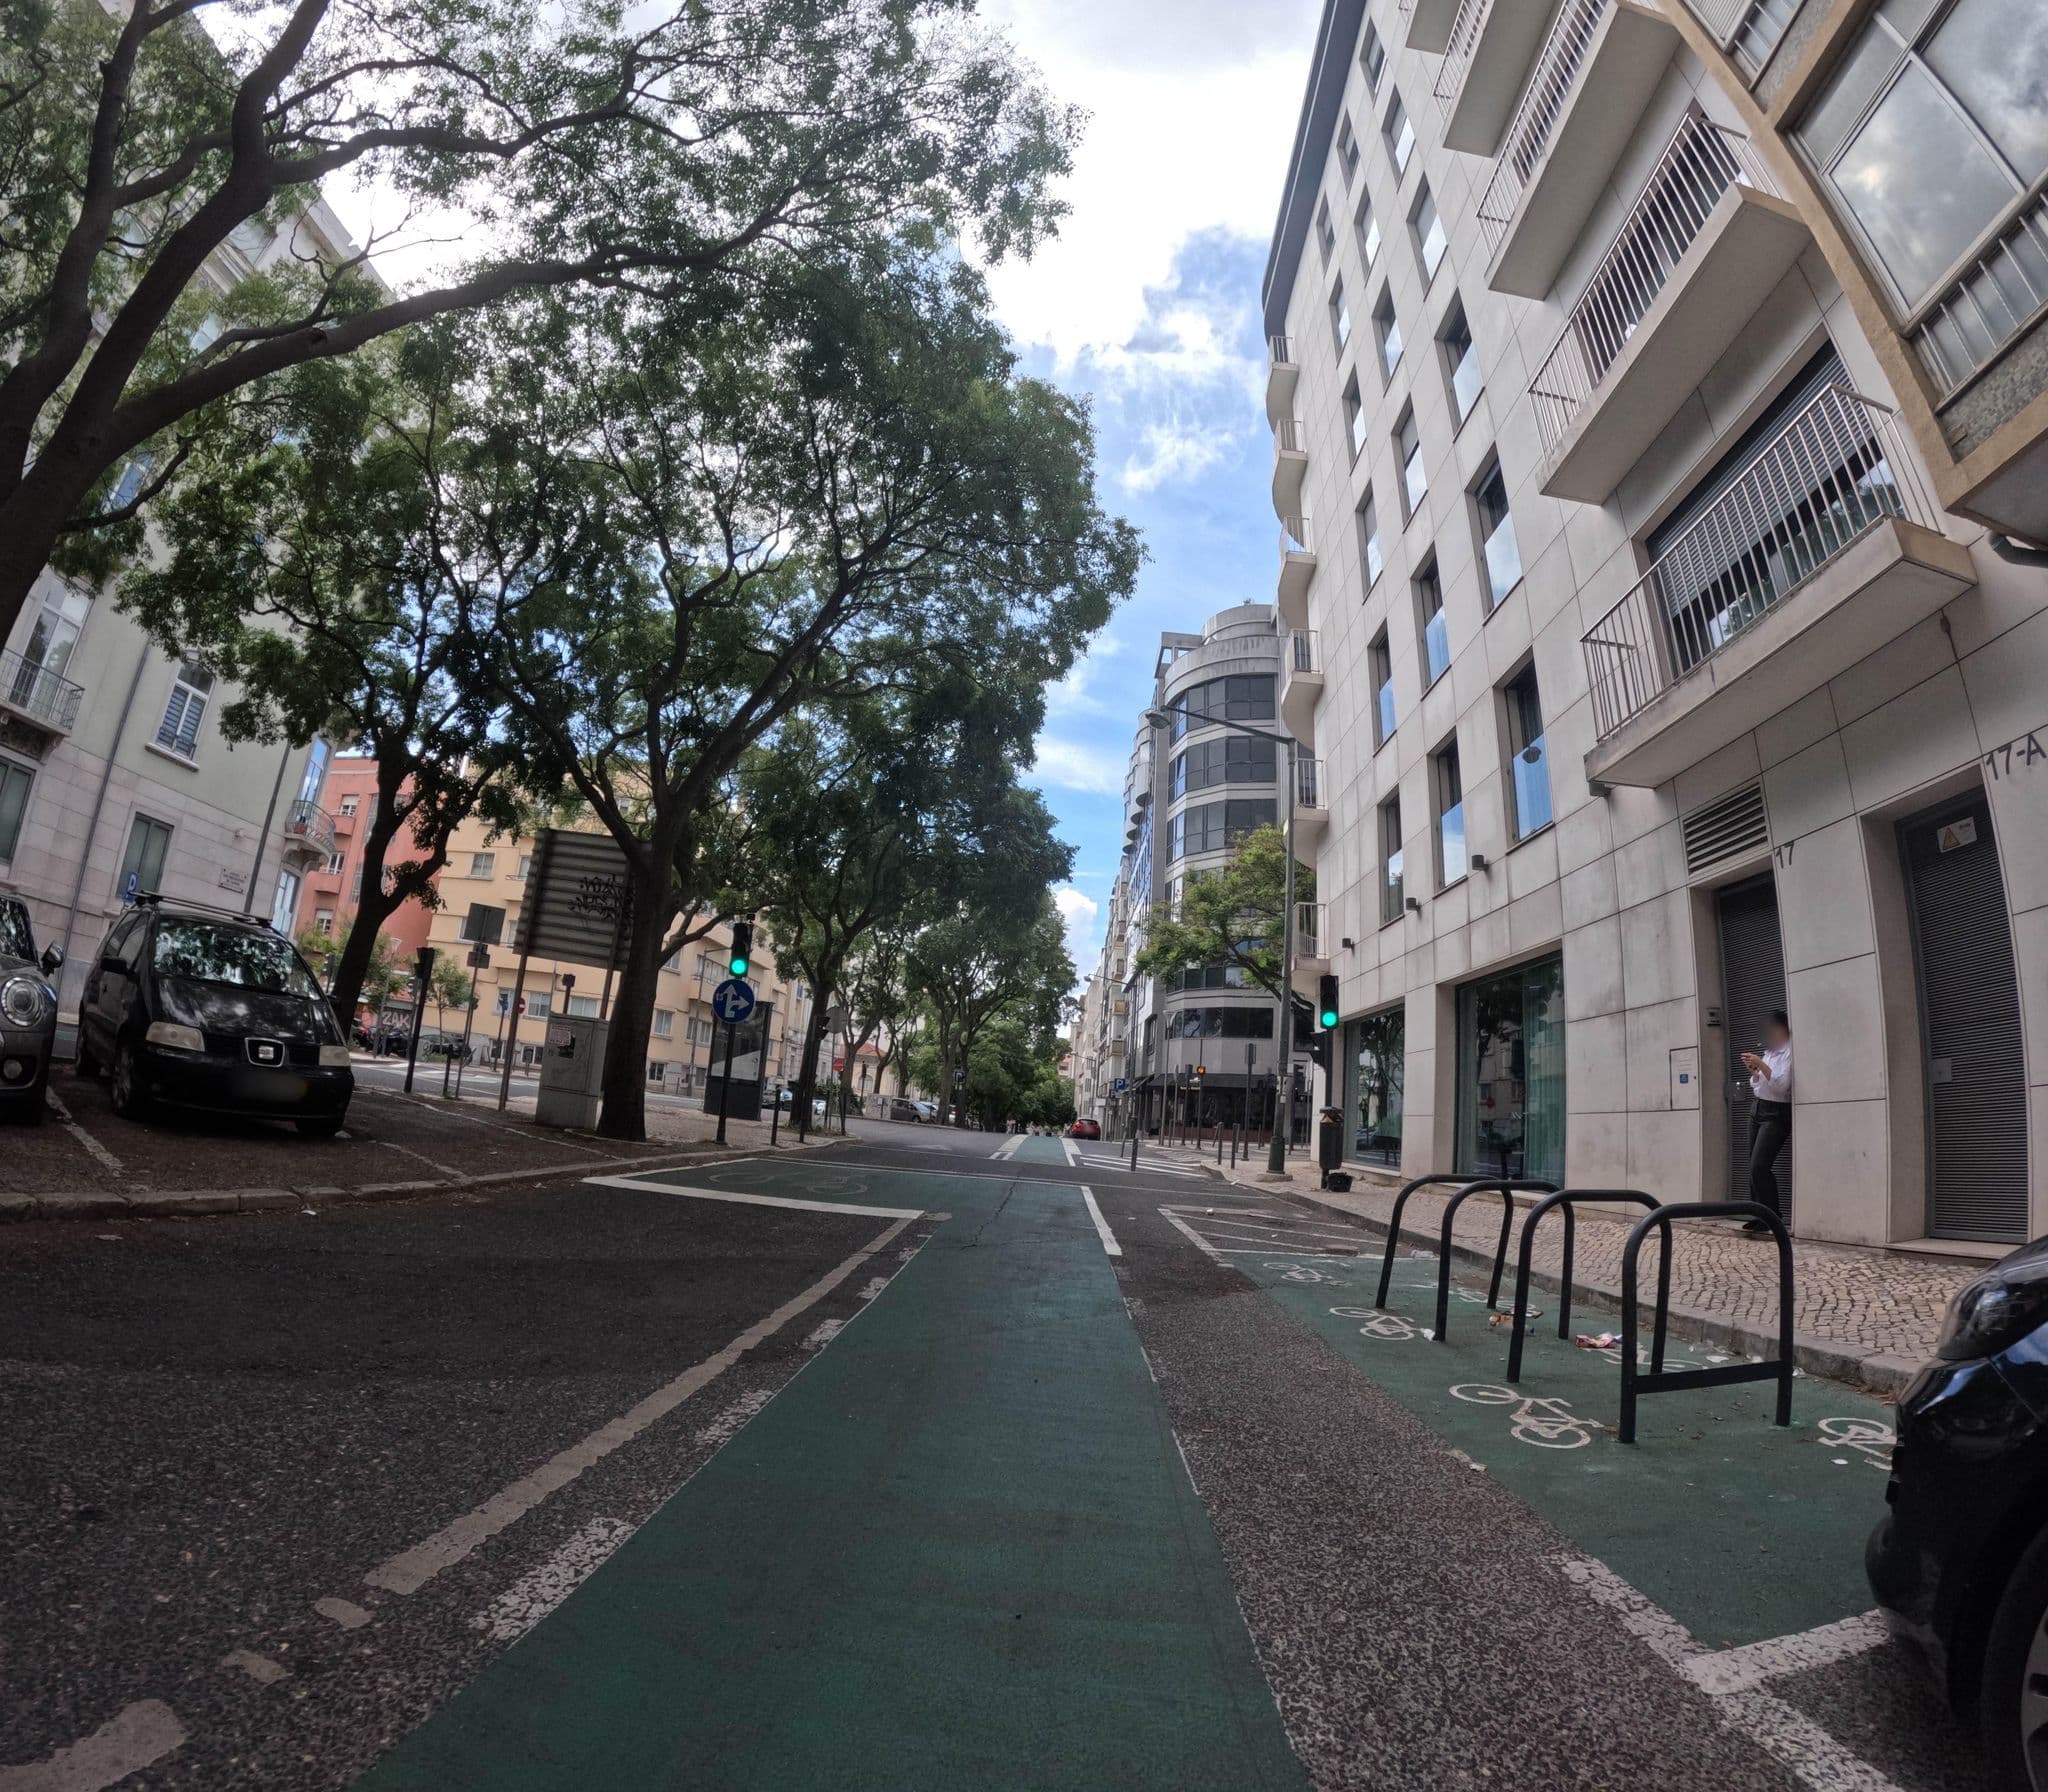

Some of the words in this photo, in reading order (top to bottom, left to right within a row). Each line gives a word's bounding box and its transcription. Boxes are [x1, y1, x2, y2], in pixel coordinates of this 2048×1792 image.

[1986, 733, 2047, 780] 17-A
[1776, 840, 1795, 869] 17
[382, 1011, 411, 1029] ZAK
[1116, 1079, 1124, 1089] P
